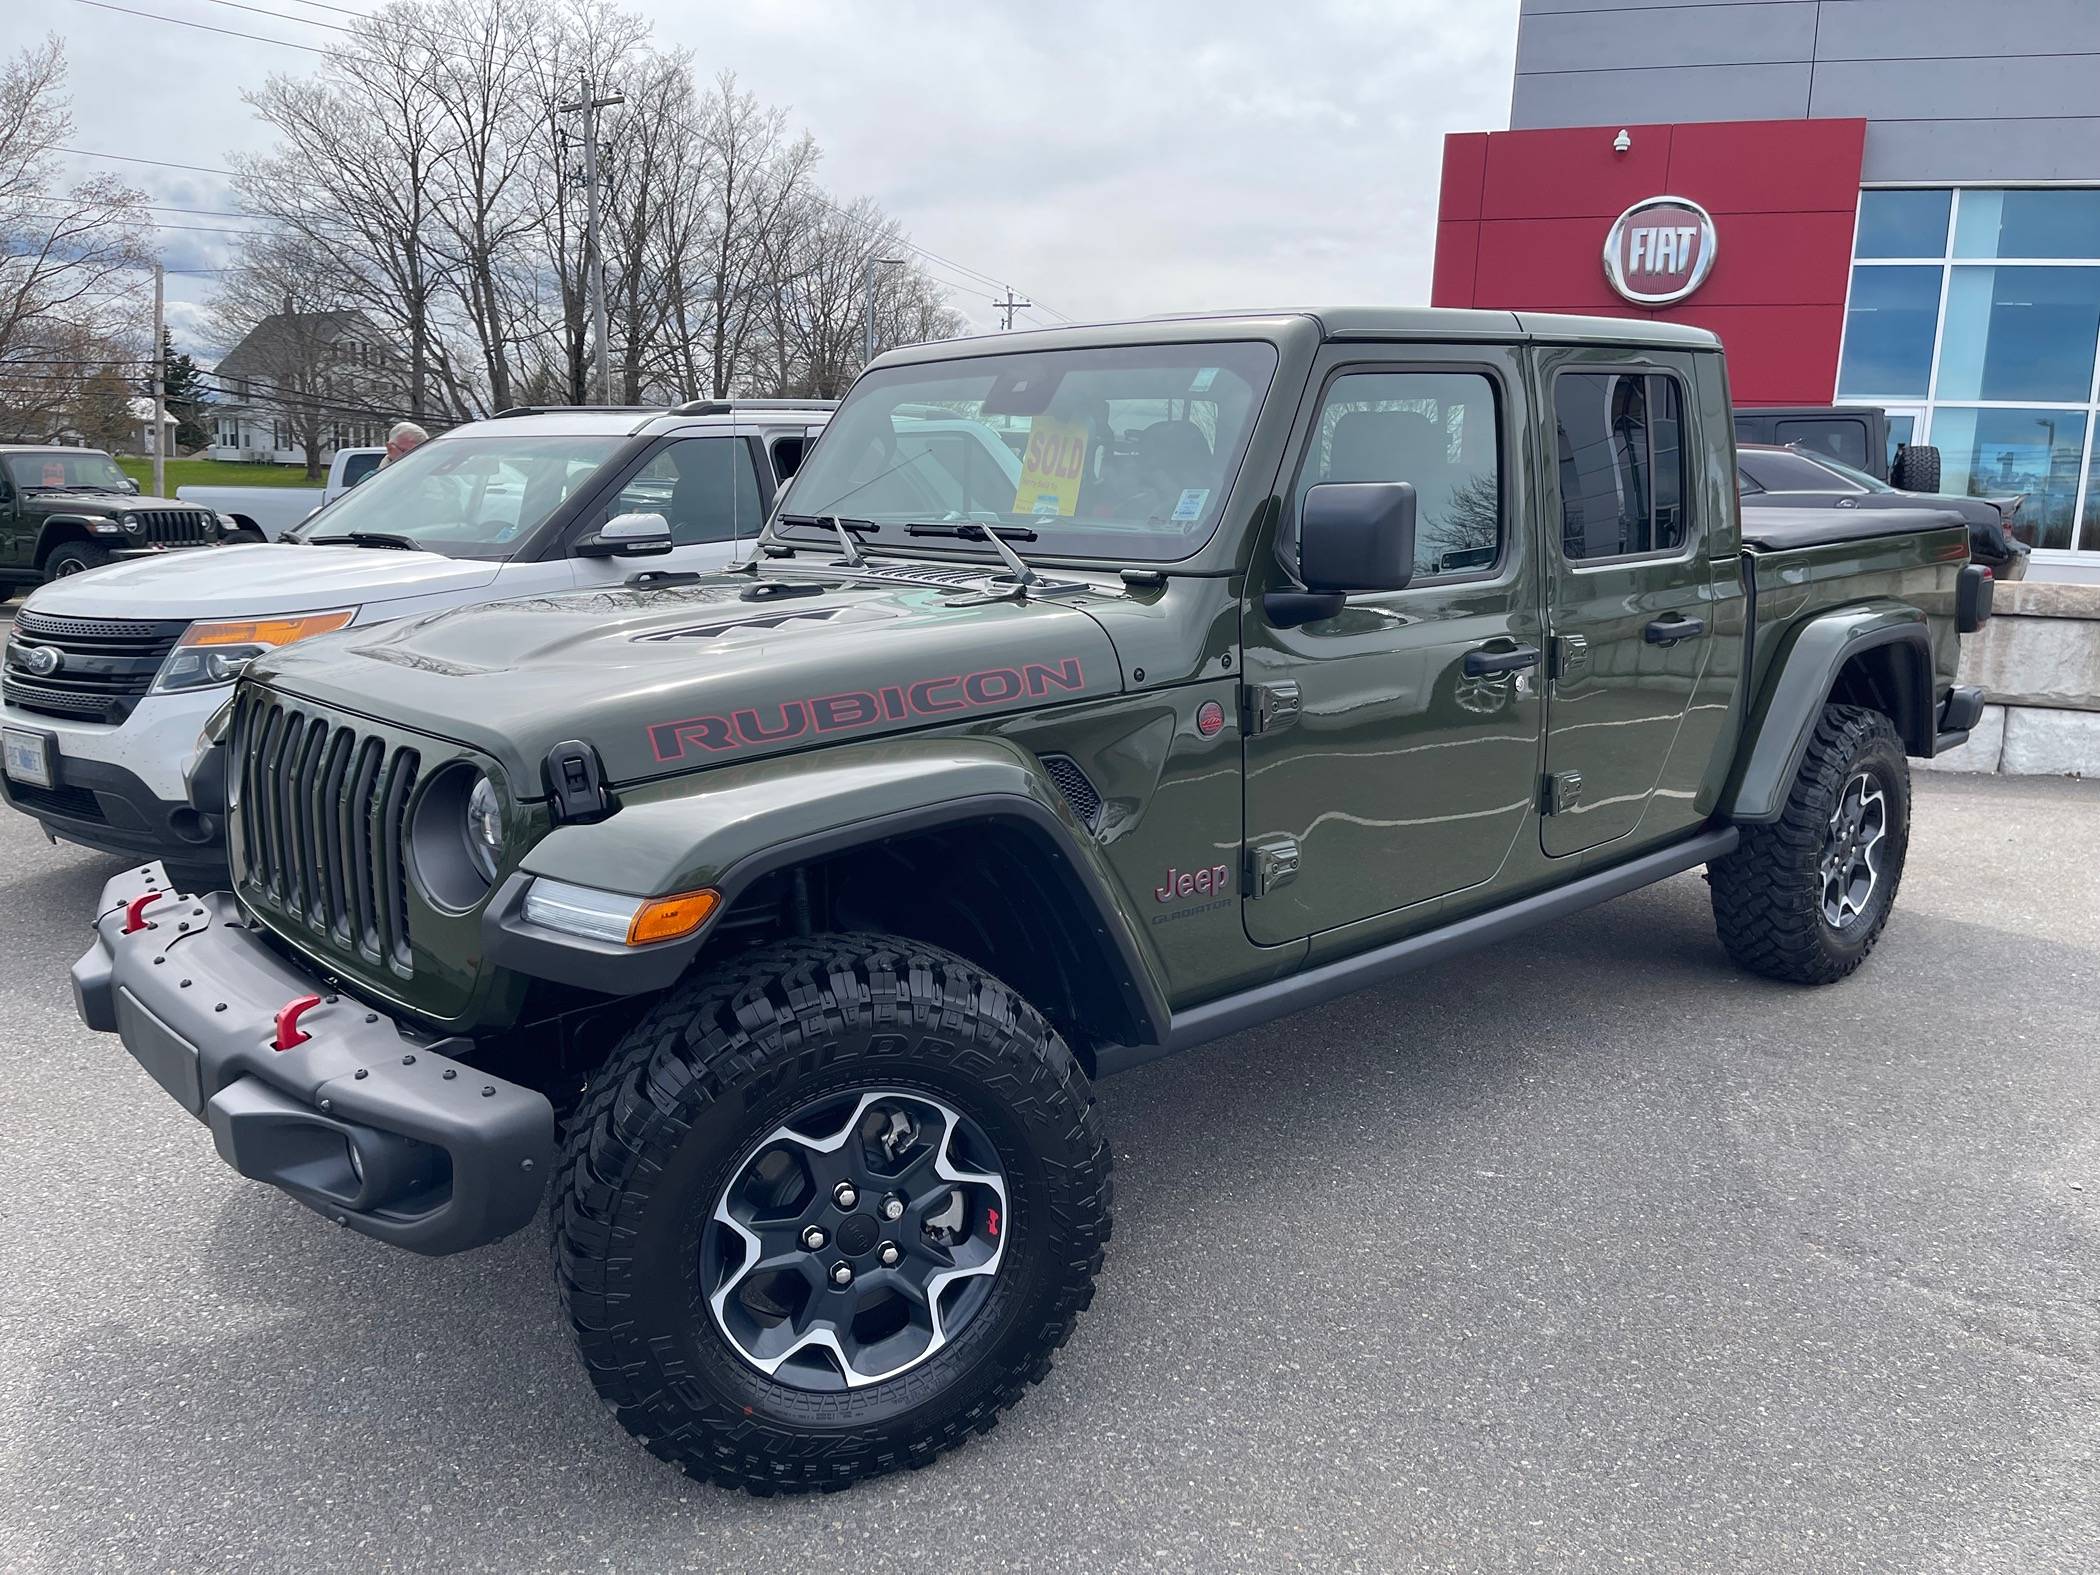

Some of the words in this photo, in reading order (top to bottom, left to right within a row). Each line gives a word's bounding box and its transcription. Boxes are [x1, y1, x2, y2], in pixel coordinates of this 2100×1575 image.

[1630, 227, 1697, 276] FIAT
[1027, 431, 1084, 479] SOLD
[648, 657, 1084, 761] RUBICON
[1155, 864, 1230, 903] Jeep
[1152, 898, 1232, 925] GLADIATOR
[742, 1033, 1050, 1130] WILDPEAK
